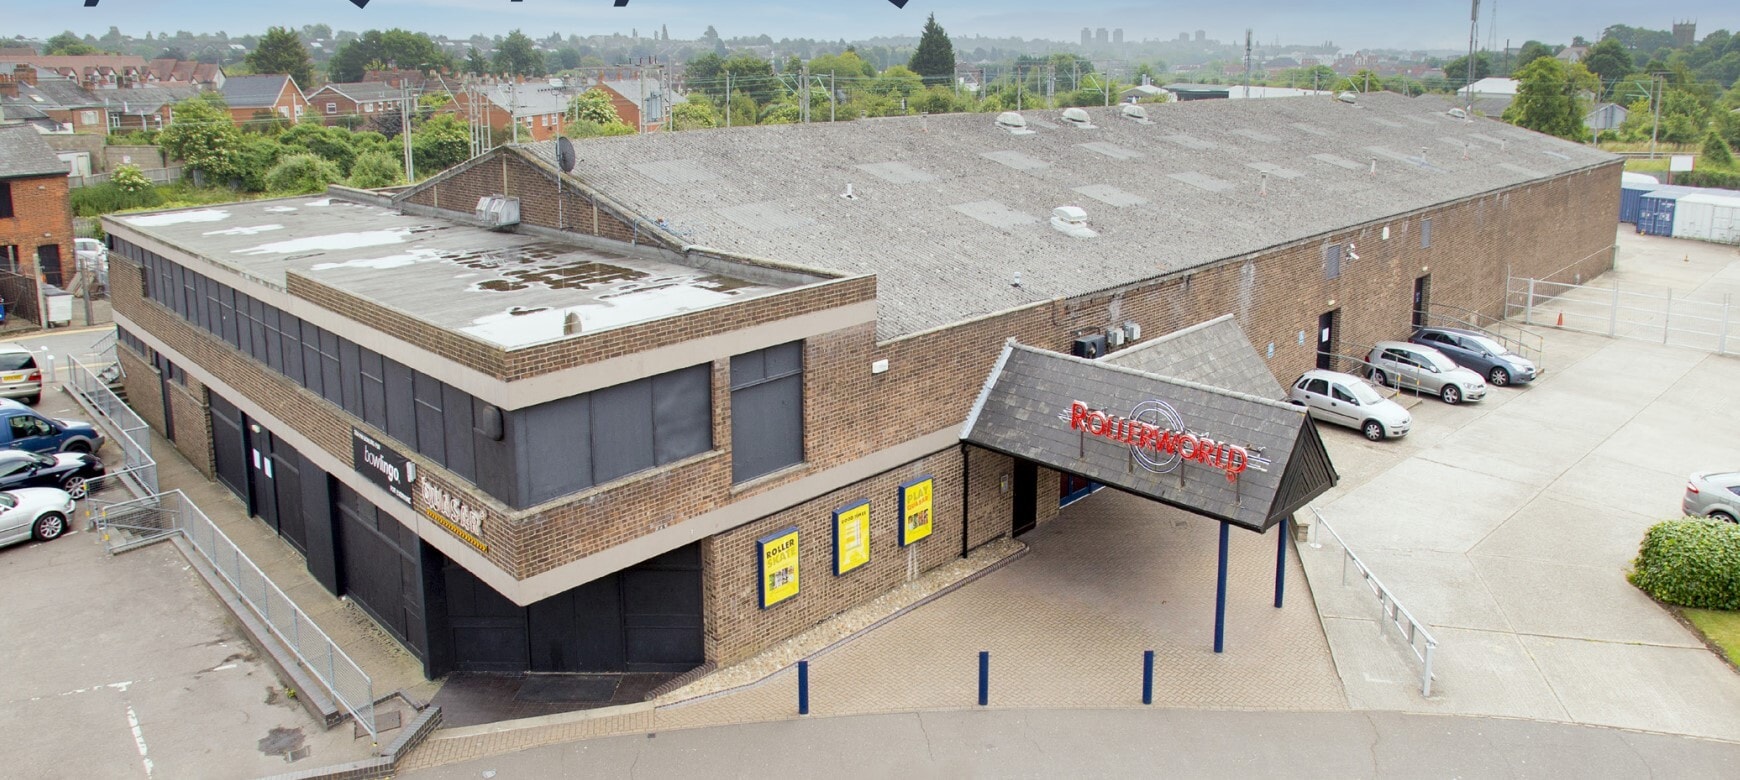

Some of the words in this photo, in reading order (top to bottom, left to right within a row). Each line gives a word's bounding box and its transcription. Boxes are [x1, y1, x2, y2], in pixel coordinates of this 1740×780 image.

[1070, 400, 1248, 474] ROLLERWORLD
[907, 485, 928, 504] PLAY
[766, 538, 795, 559] ROLLER
[767, 548, 796, 569] SKATE
